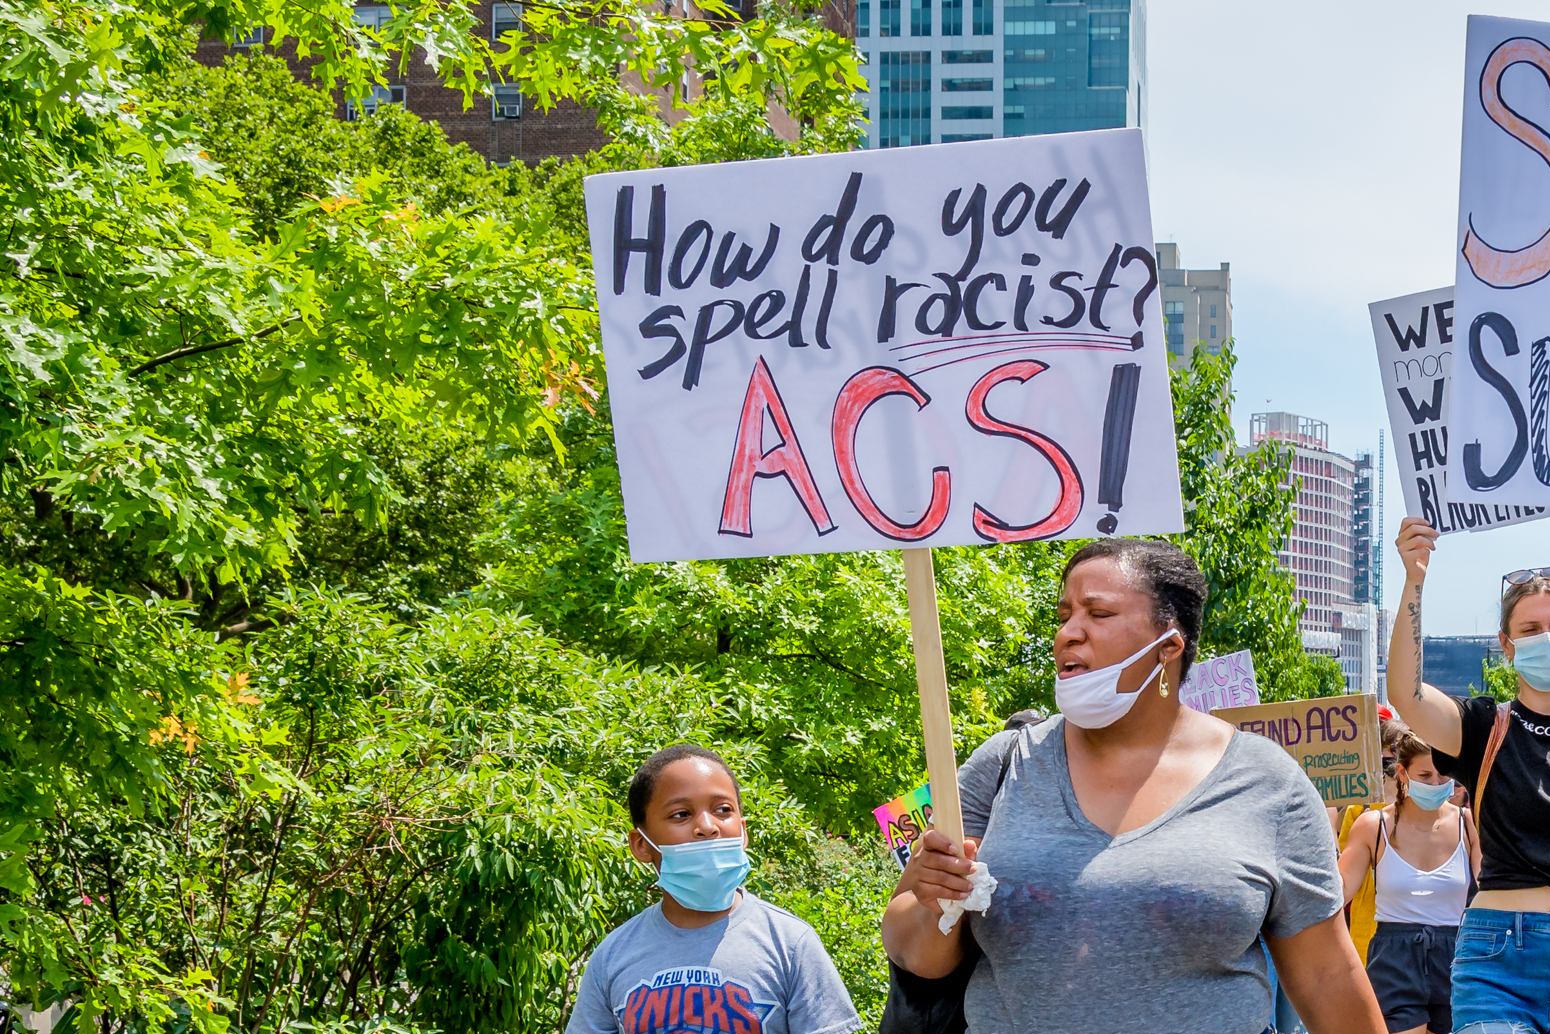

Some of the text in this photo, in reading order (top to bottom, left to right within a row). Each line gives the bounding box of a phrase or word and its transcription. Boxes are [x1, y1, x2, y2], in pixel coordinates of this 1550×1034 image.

[613, 171, 1091, 297] How do you
[637, 243, 1159, 391] spell racist?
[1394, 351, 1453, 383] mor
[717, 355, 1142, 543] ACS!
[1408, 425, 1448, 472] HU
[1182, 654, 1248, 695] LACK
[1186, 677, 1257, 715] MILIES
[1306, 705, 1358, 744] ACS
[653, 969, 721, 987] NEW YORK
